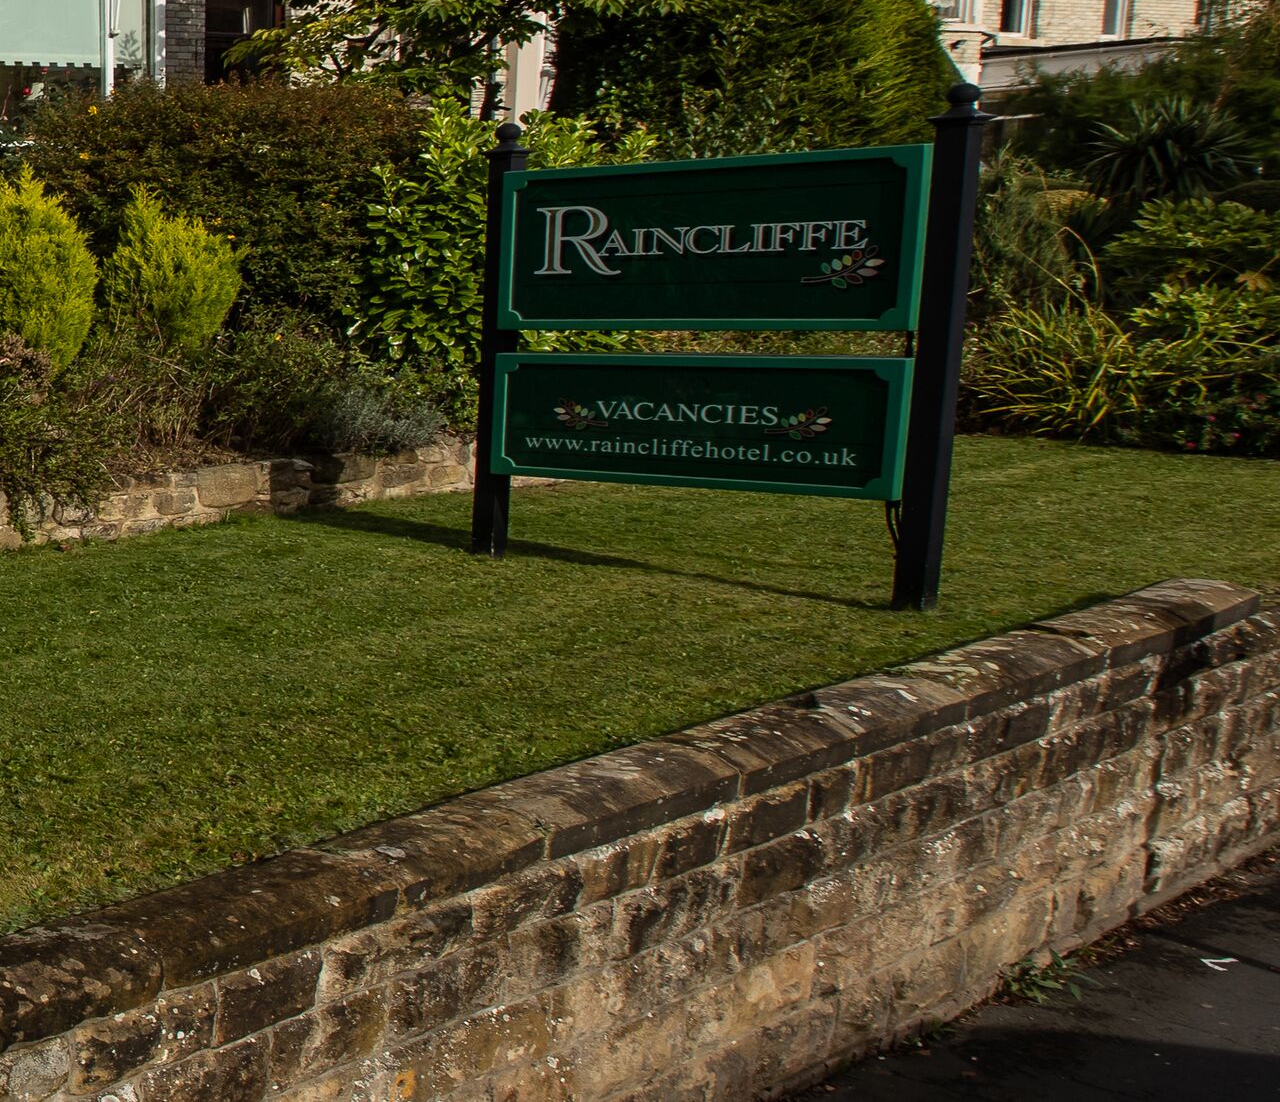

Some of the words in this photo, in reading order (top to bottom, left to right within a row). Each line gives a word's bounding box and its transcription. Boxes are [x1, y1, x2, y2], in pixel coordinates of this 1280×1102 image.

[534, 205, 871, 277] RAINCLIFFE
[595, 400, 780, 427] VACANCIES
[525, 435, 858, 467] www.raincliffehotel.co.uk
